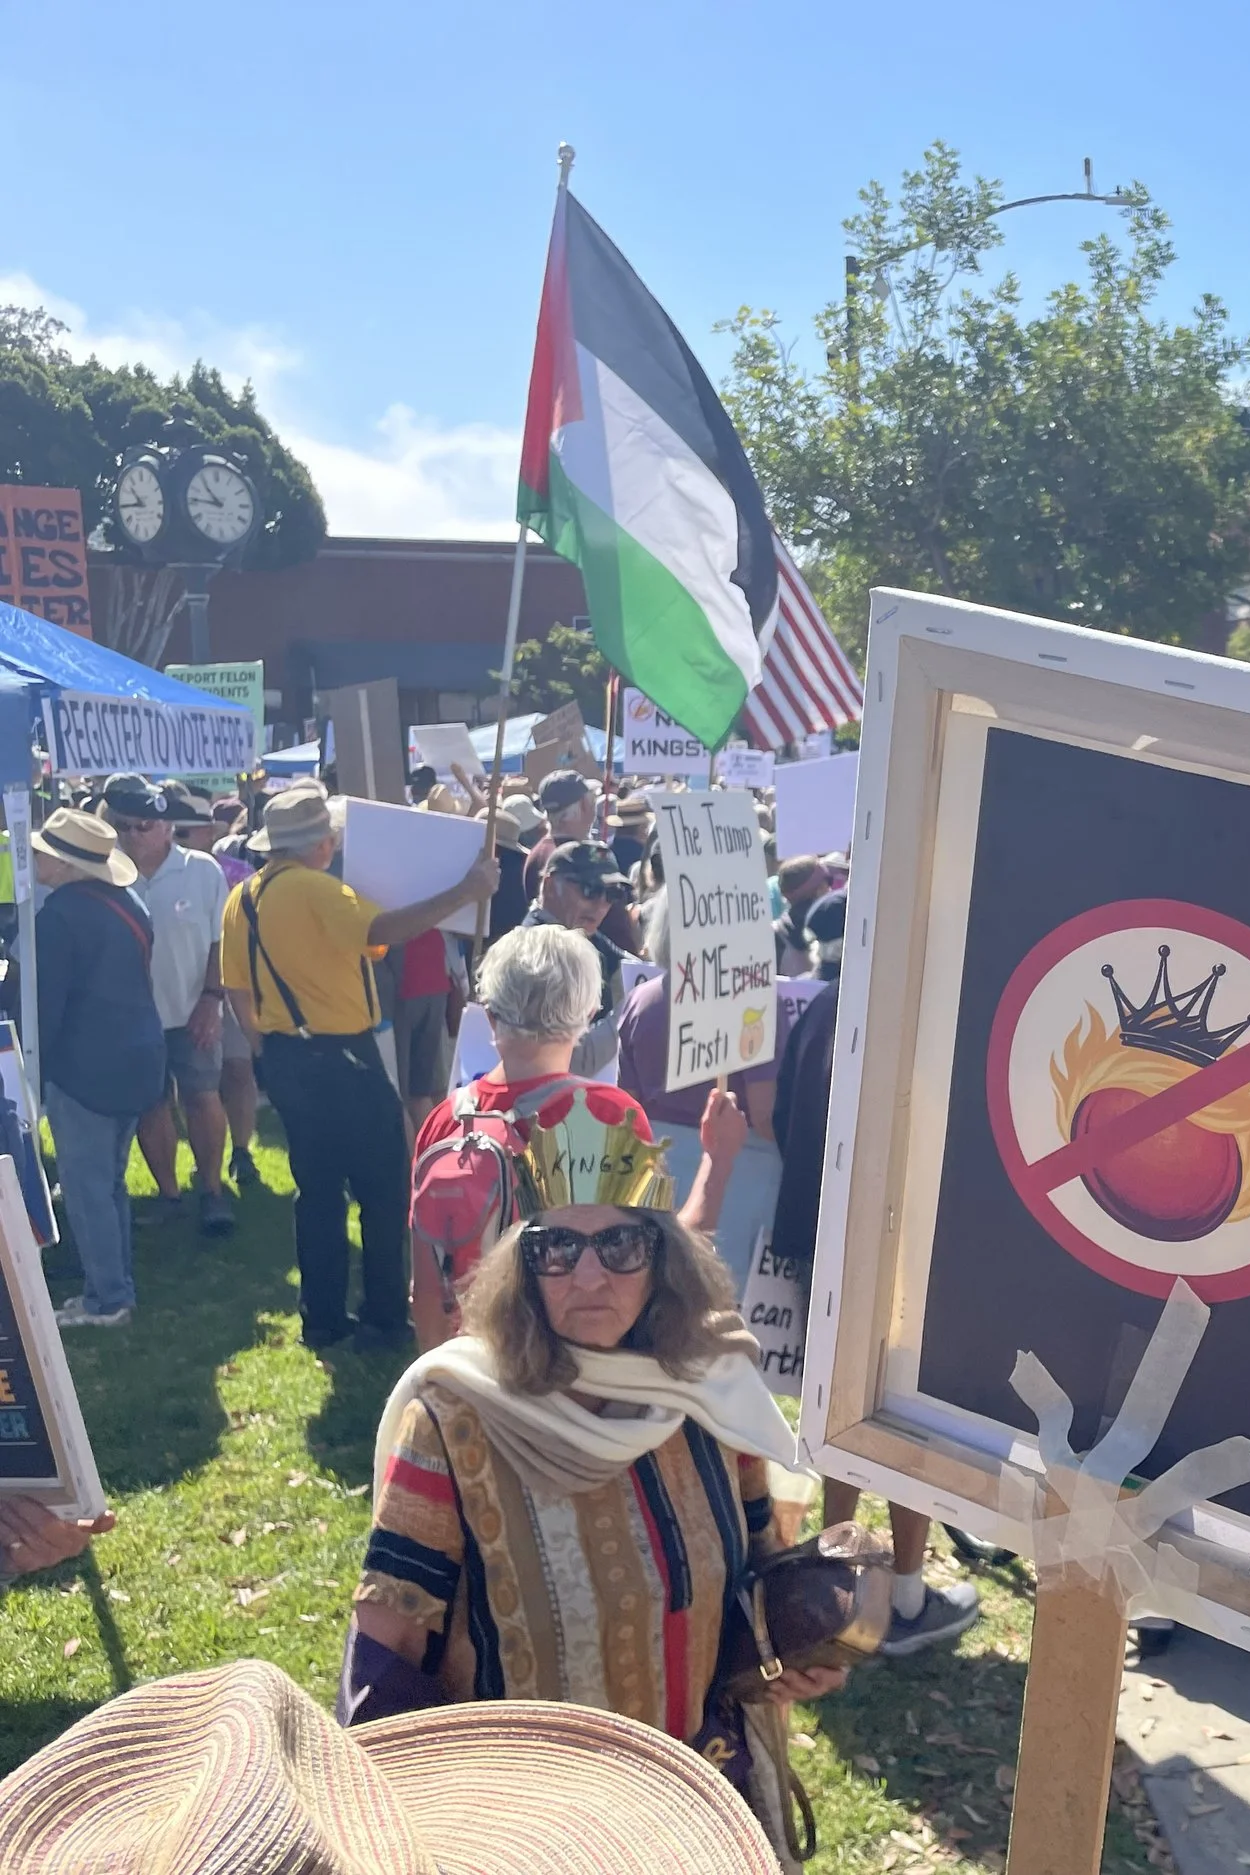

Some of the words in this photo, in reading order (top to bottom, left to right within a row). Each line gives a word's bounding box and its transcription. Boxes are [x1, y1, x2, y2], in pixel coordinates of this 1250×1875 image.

[220, 669, 256, 683] FELON
[57, 700, 147, 769] REGISTER
[144, 708, 170, 768] TO
[168, 711, 212, 770] VOTE
[631, 739, 707, 757] KINGS
[662, 805, 702, 857] The
[701, 802, 753, 858] Trump
[679, 873, 765, 928] Doctrine:
[758, 1244, 801, 1283] Eve
[750, 1301, 793, 1329] can
[759, 1343, 804, 1378] rth
